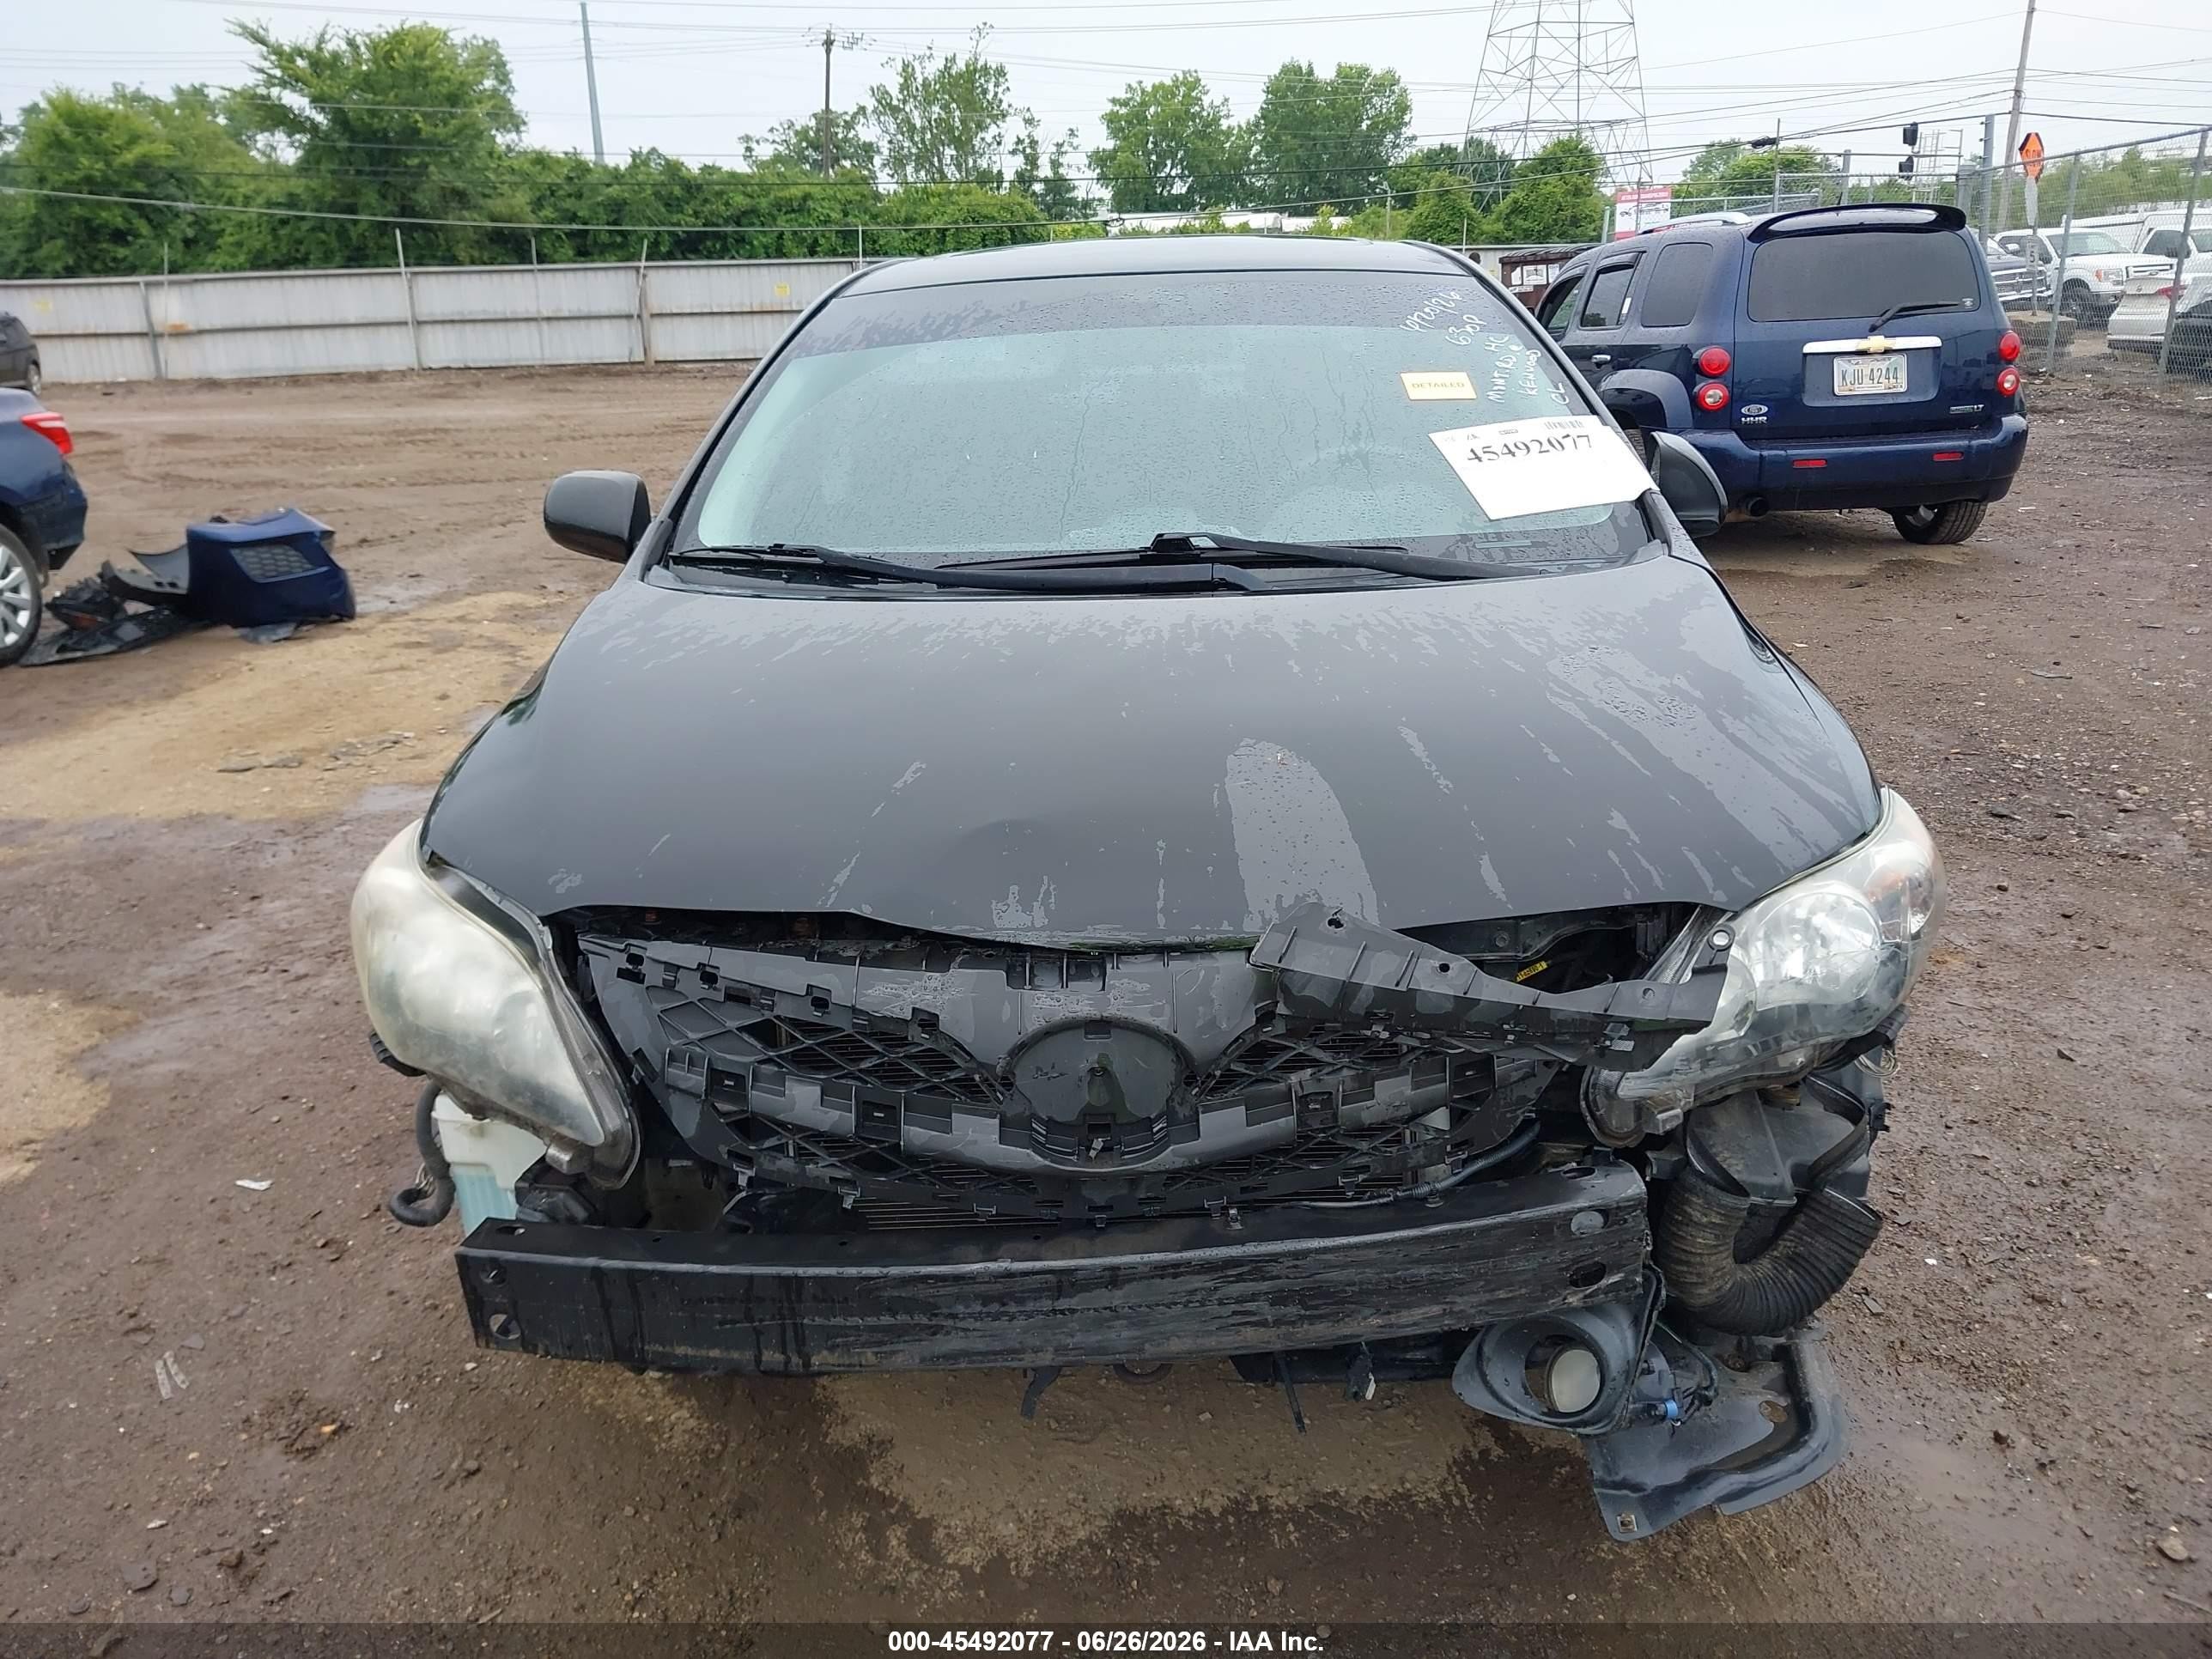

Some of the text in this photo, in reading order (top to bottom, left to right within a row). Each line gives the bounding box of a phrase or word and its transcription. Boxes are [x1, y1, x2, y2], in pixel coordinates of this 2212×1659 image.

[1841, 367, 1899, 386] KJU 4244
[1973, 404, 1985, 412] LT
[1741, 416, 1768, 425] HHR
[1467, 434, 1592, 463] 45492077
